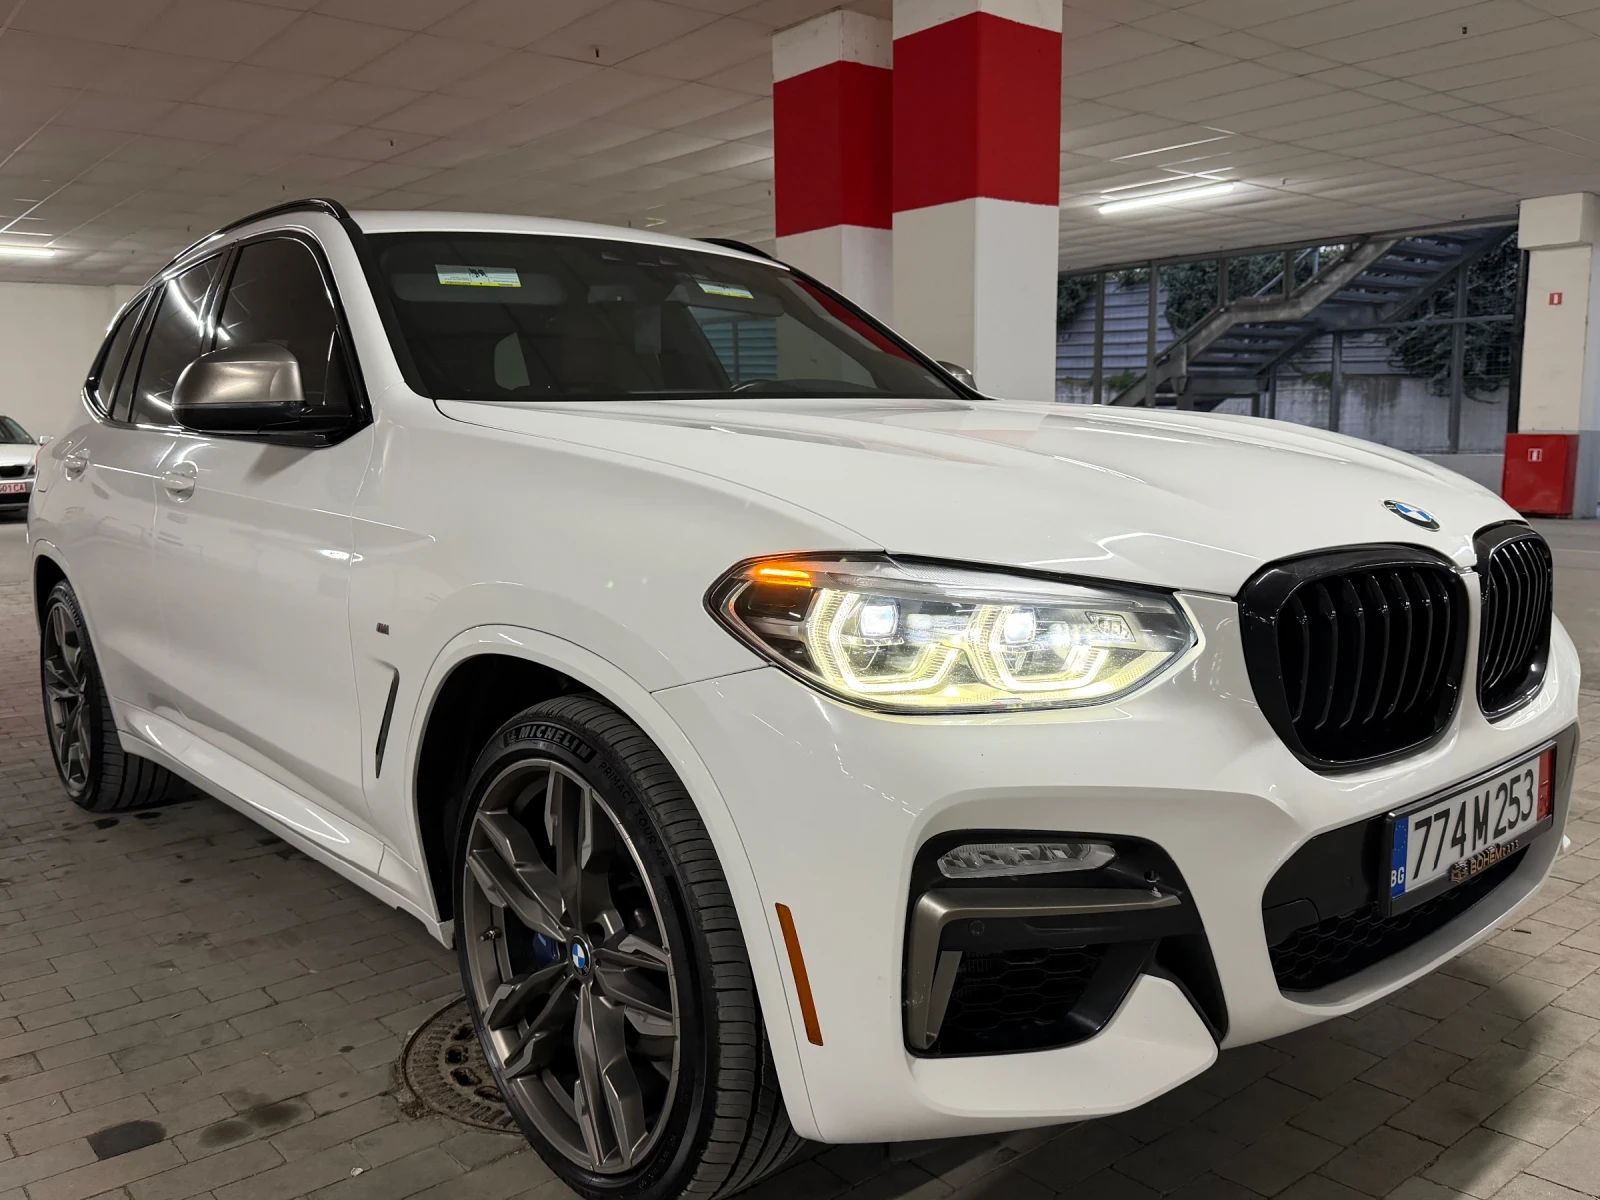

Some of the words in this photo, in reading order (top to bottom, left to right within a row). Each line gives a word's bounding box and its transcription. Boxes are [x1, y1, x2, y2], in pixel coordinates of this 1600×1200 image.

[518, 724, 593, 759] MICHELIN
[599, 761, 637, 806] PRIMACY
[634, 809, 657, 845] TOUR
[1390, 866, 1405, 888] BG
